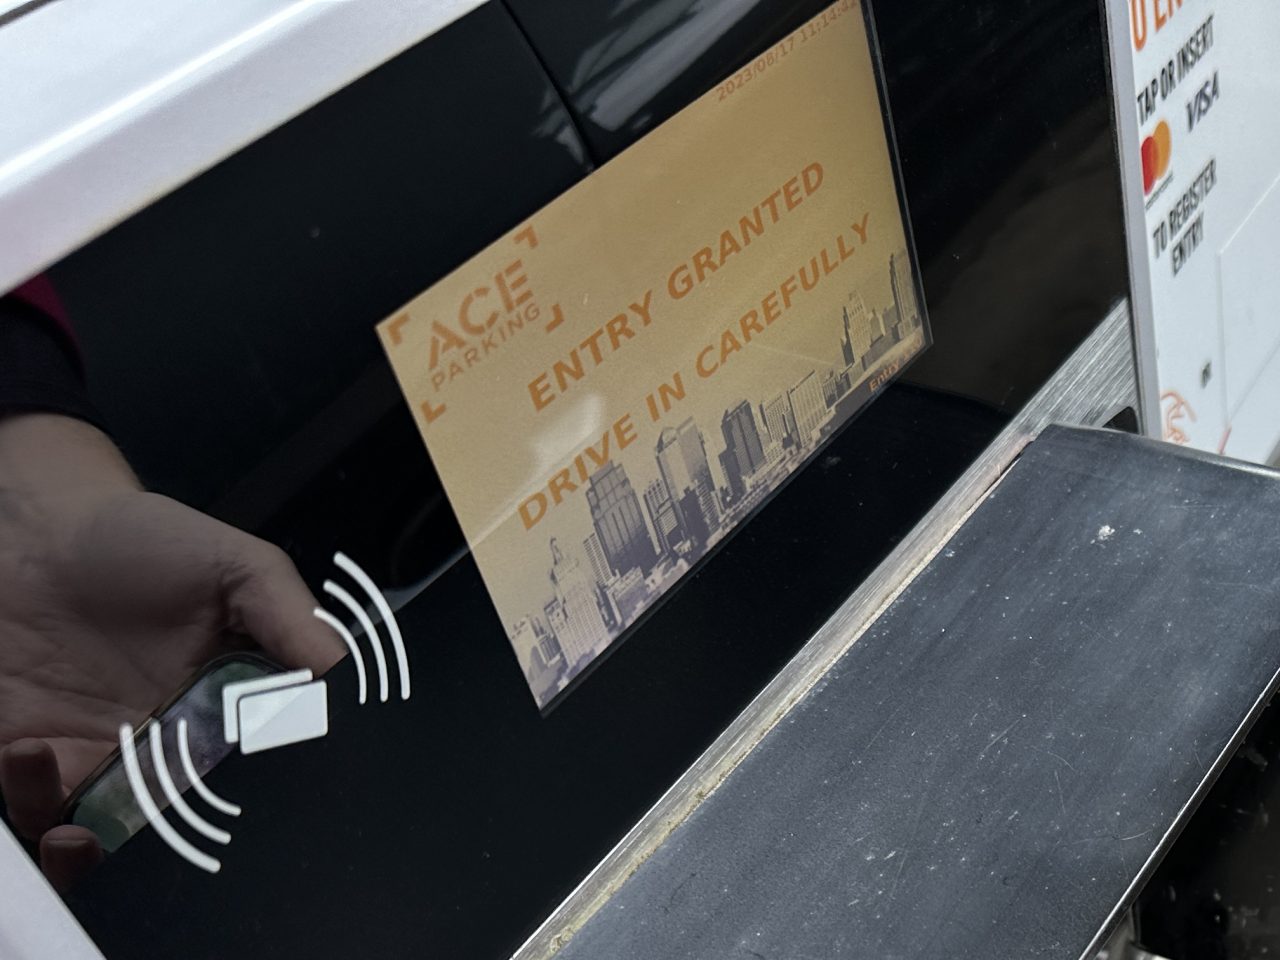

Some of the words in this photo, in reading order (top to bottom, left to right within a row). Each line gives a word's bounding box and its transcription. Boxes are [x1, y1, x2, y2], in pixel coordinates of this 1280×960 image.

[1137, 78, 1158, 126] TAP
[1160, 60, 1176, 101] OR
[1177, 13, 1214, 83] INSERT
[1186, 70, 1219, 133] VISA
[1153, 220, 1168, 260] TO
[1170, 158, 1217, 241] REGISTER
[1172, 210, 1204, 277] ENTRY
[428, 259, 534, 370] ACE
[527, 289, 653, 413] ENTRY
[666, 161, 824, 301] GRANTED
[431, 302, 541, 392] PARKING
[516, 413, 638, 531] DRIVE
[644, 371, 686, 422] IN
[695, 212, 870, 379] CAREFULLY
